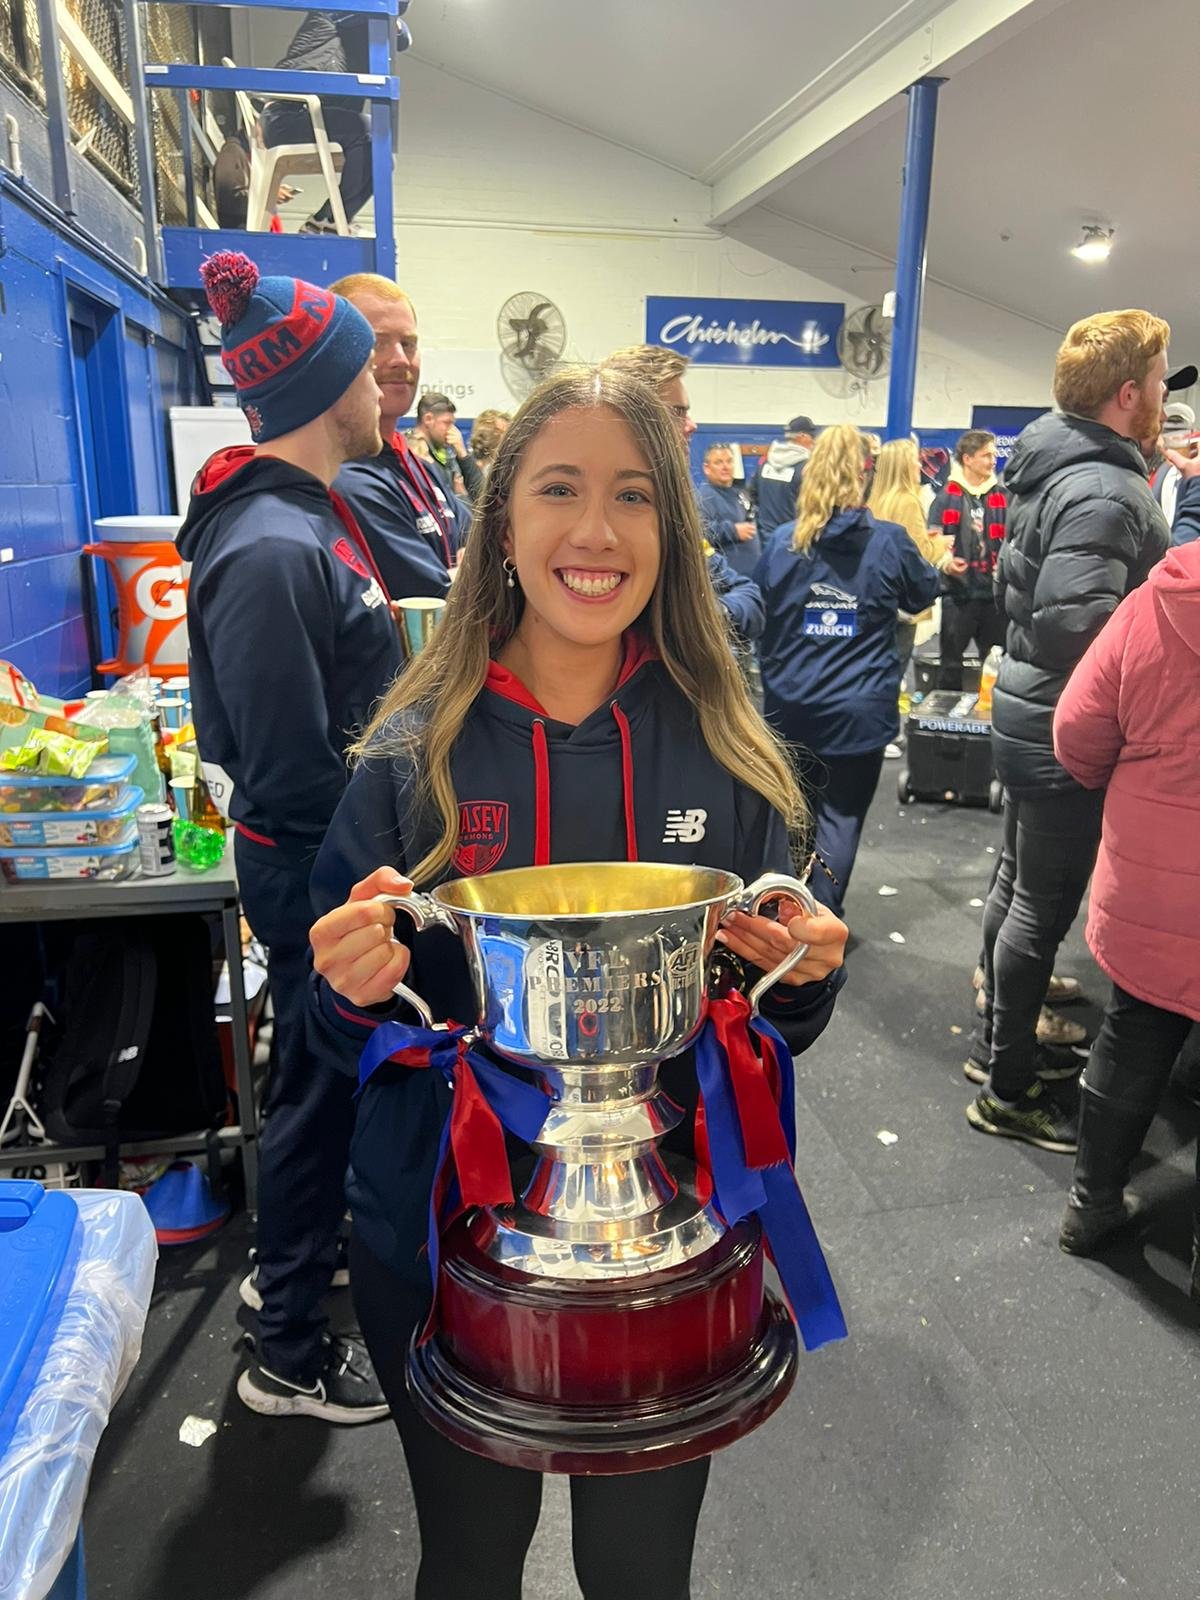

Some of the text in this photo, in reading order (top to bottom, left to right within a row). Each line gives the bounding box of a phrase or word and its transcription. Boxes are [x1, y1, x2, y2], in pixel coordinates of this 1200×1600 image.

[660, 315, 788, 345] Chisholm
[420, 380, 475, 399] prings
[136, 566, 188, 620] G
[804, 601, 858, 609] JAGUAR
[806, 623, 853, 636] ZURICH
[919, 719, 990, 734] POWERADE
[461, 805, 503, 832] ASEY
[563, 949, 627, 974] VFL
[530, 969, 662, 992] PREMIERS
[574, 997, 624, 1014] 2022
